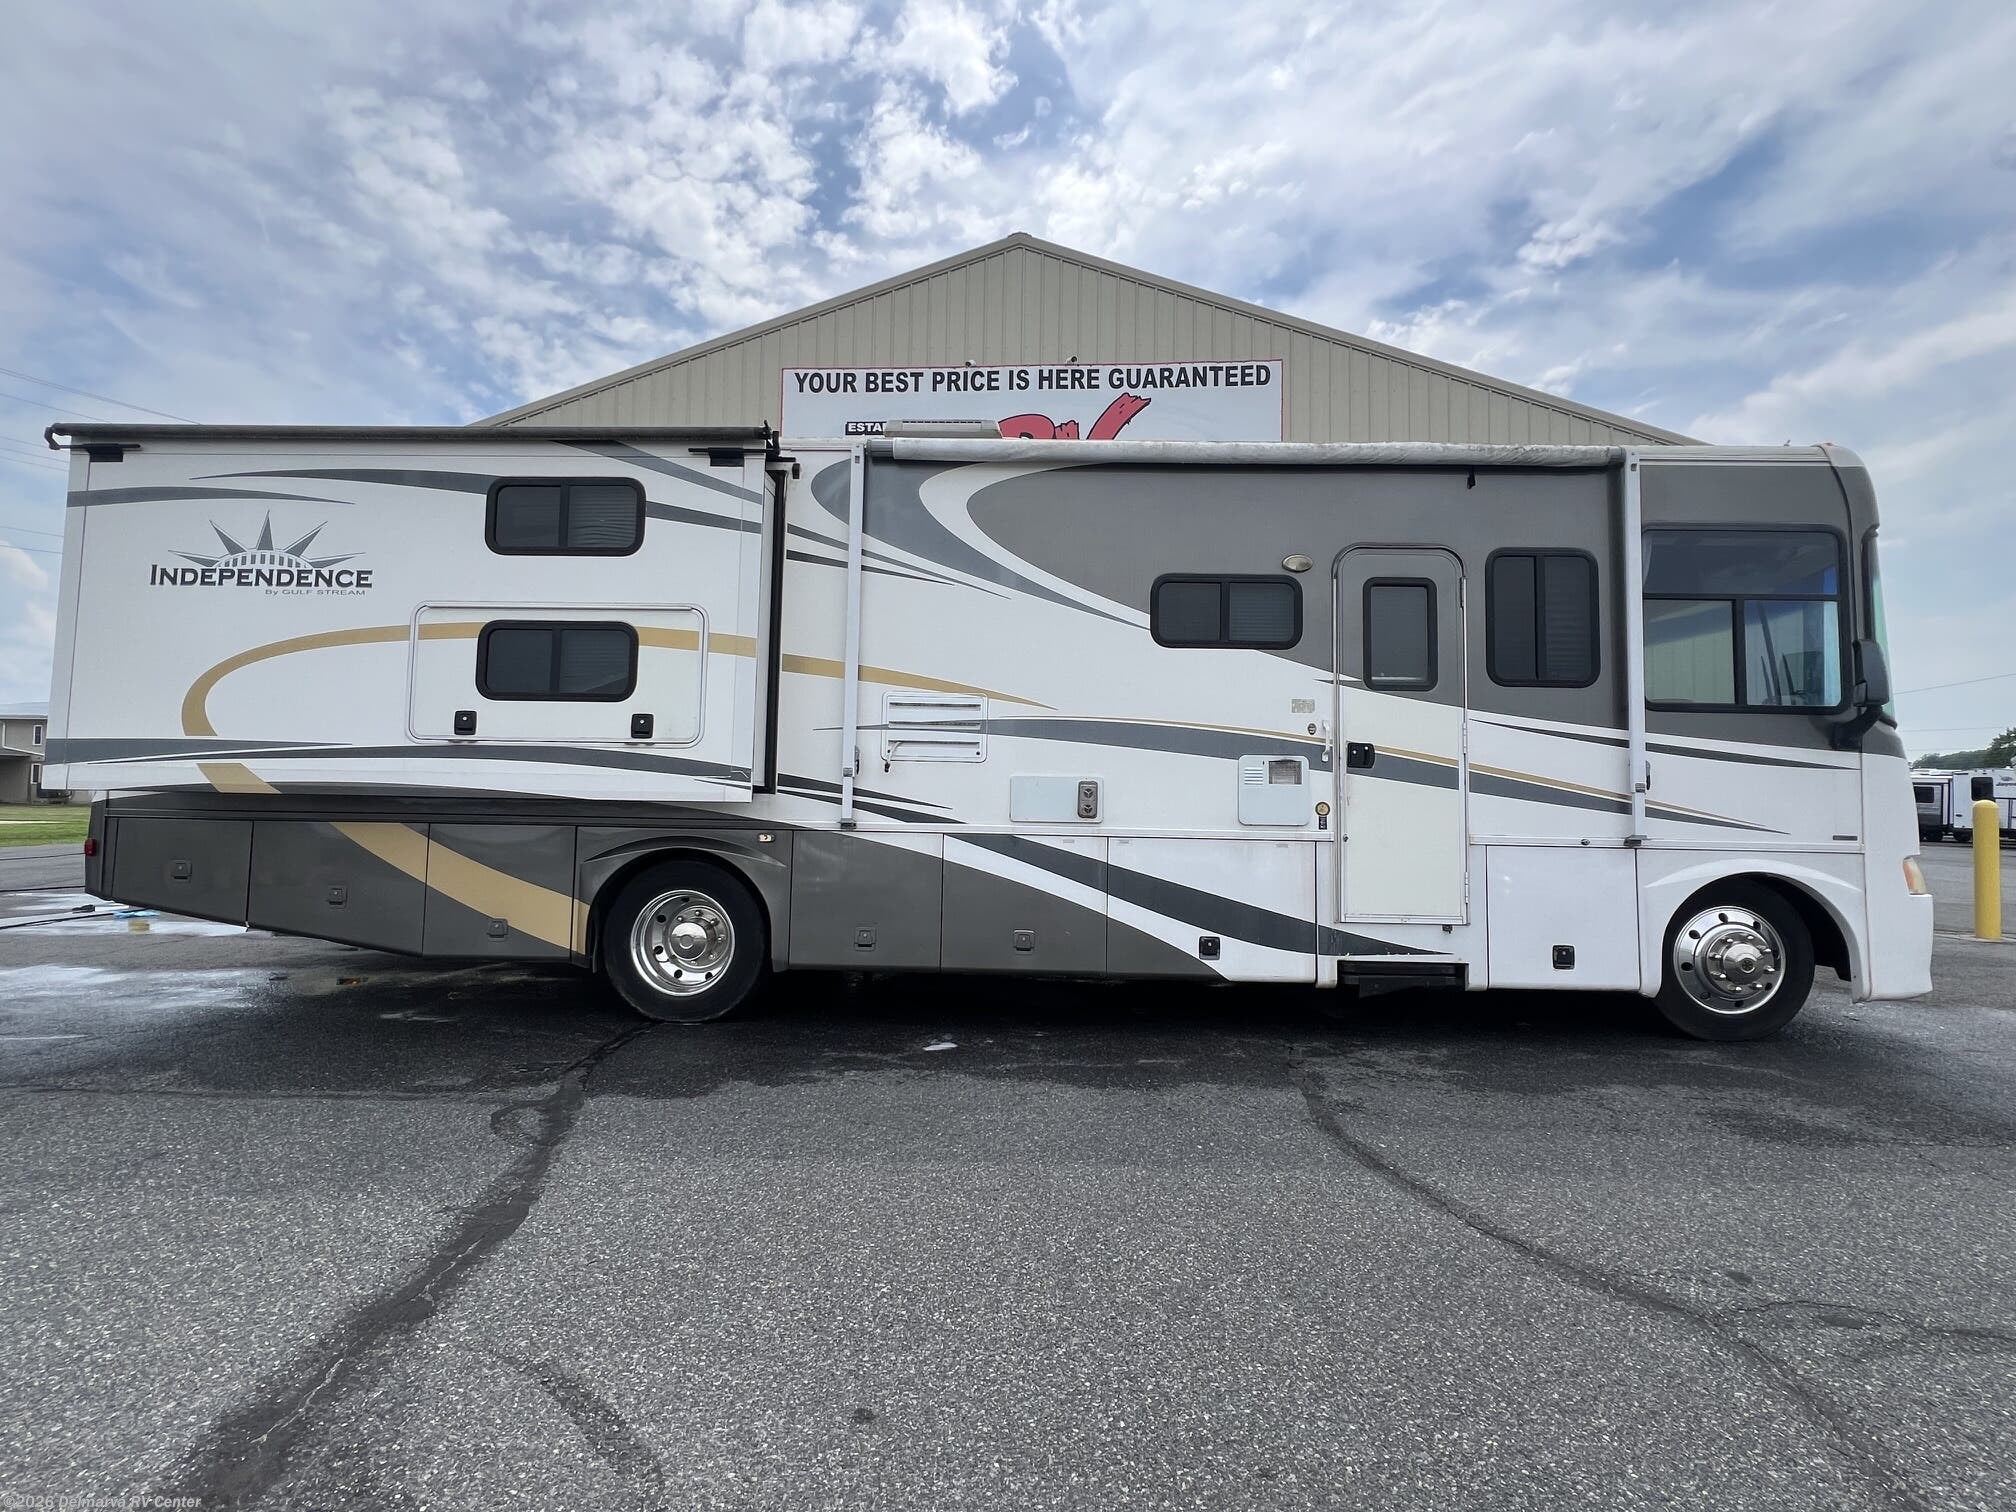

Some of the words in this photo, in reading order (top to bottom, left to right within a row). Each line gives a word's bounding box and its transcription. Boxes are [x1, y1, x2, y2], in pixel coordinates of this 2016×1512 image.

[795, 372, 857, 393] YOUR
[865, 372, 923, 393] BEST
[932, 370, 1000, 392] PRICE
[1008, 369, 1030, 391] IS
[1038, 368, 1100, 390] HERE
[1108, 364, 1271, 389] GUARANTEED
[150, 564, 373, 588] INDEPENDENCE
